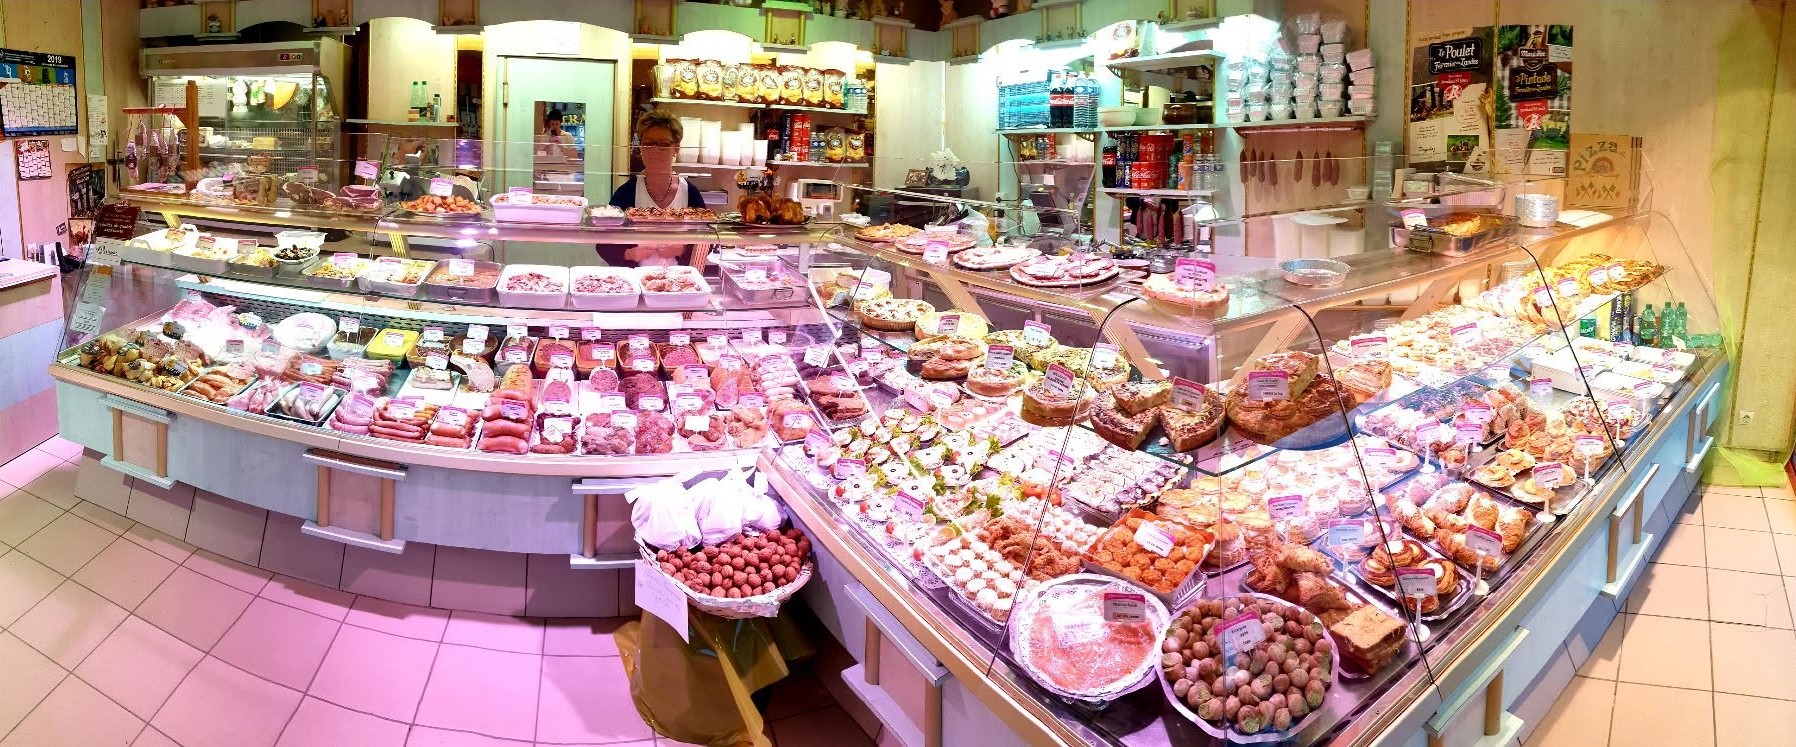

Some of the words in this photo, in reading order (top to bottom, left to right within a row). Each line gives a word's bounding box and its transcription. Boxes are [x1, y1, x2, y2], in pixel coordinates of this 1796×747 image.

[1445, 43, 1475, 59] Poulet
[47, 54, 62, 63] 2019
[1460, 57, 1479, 67] Landes
[1520, 71, 1551, 85] Pintade
